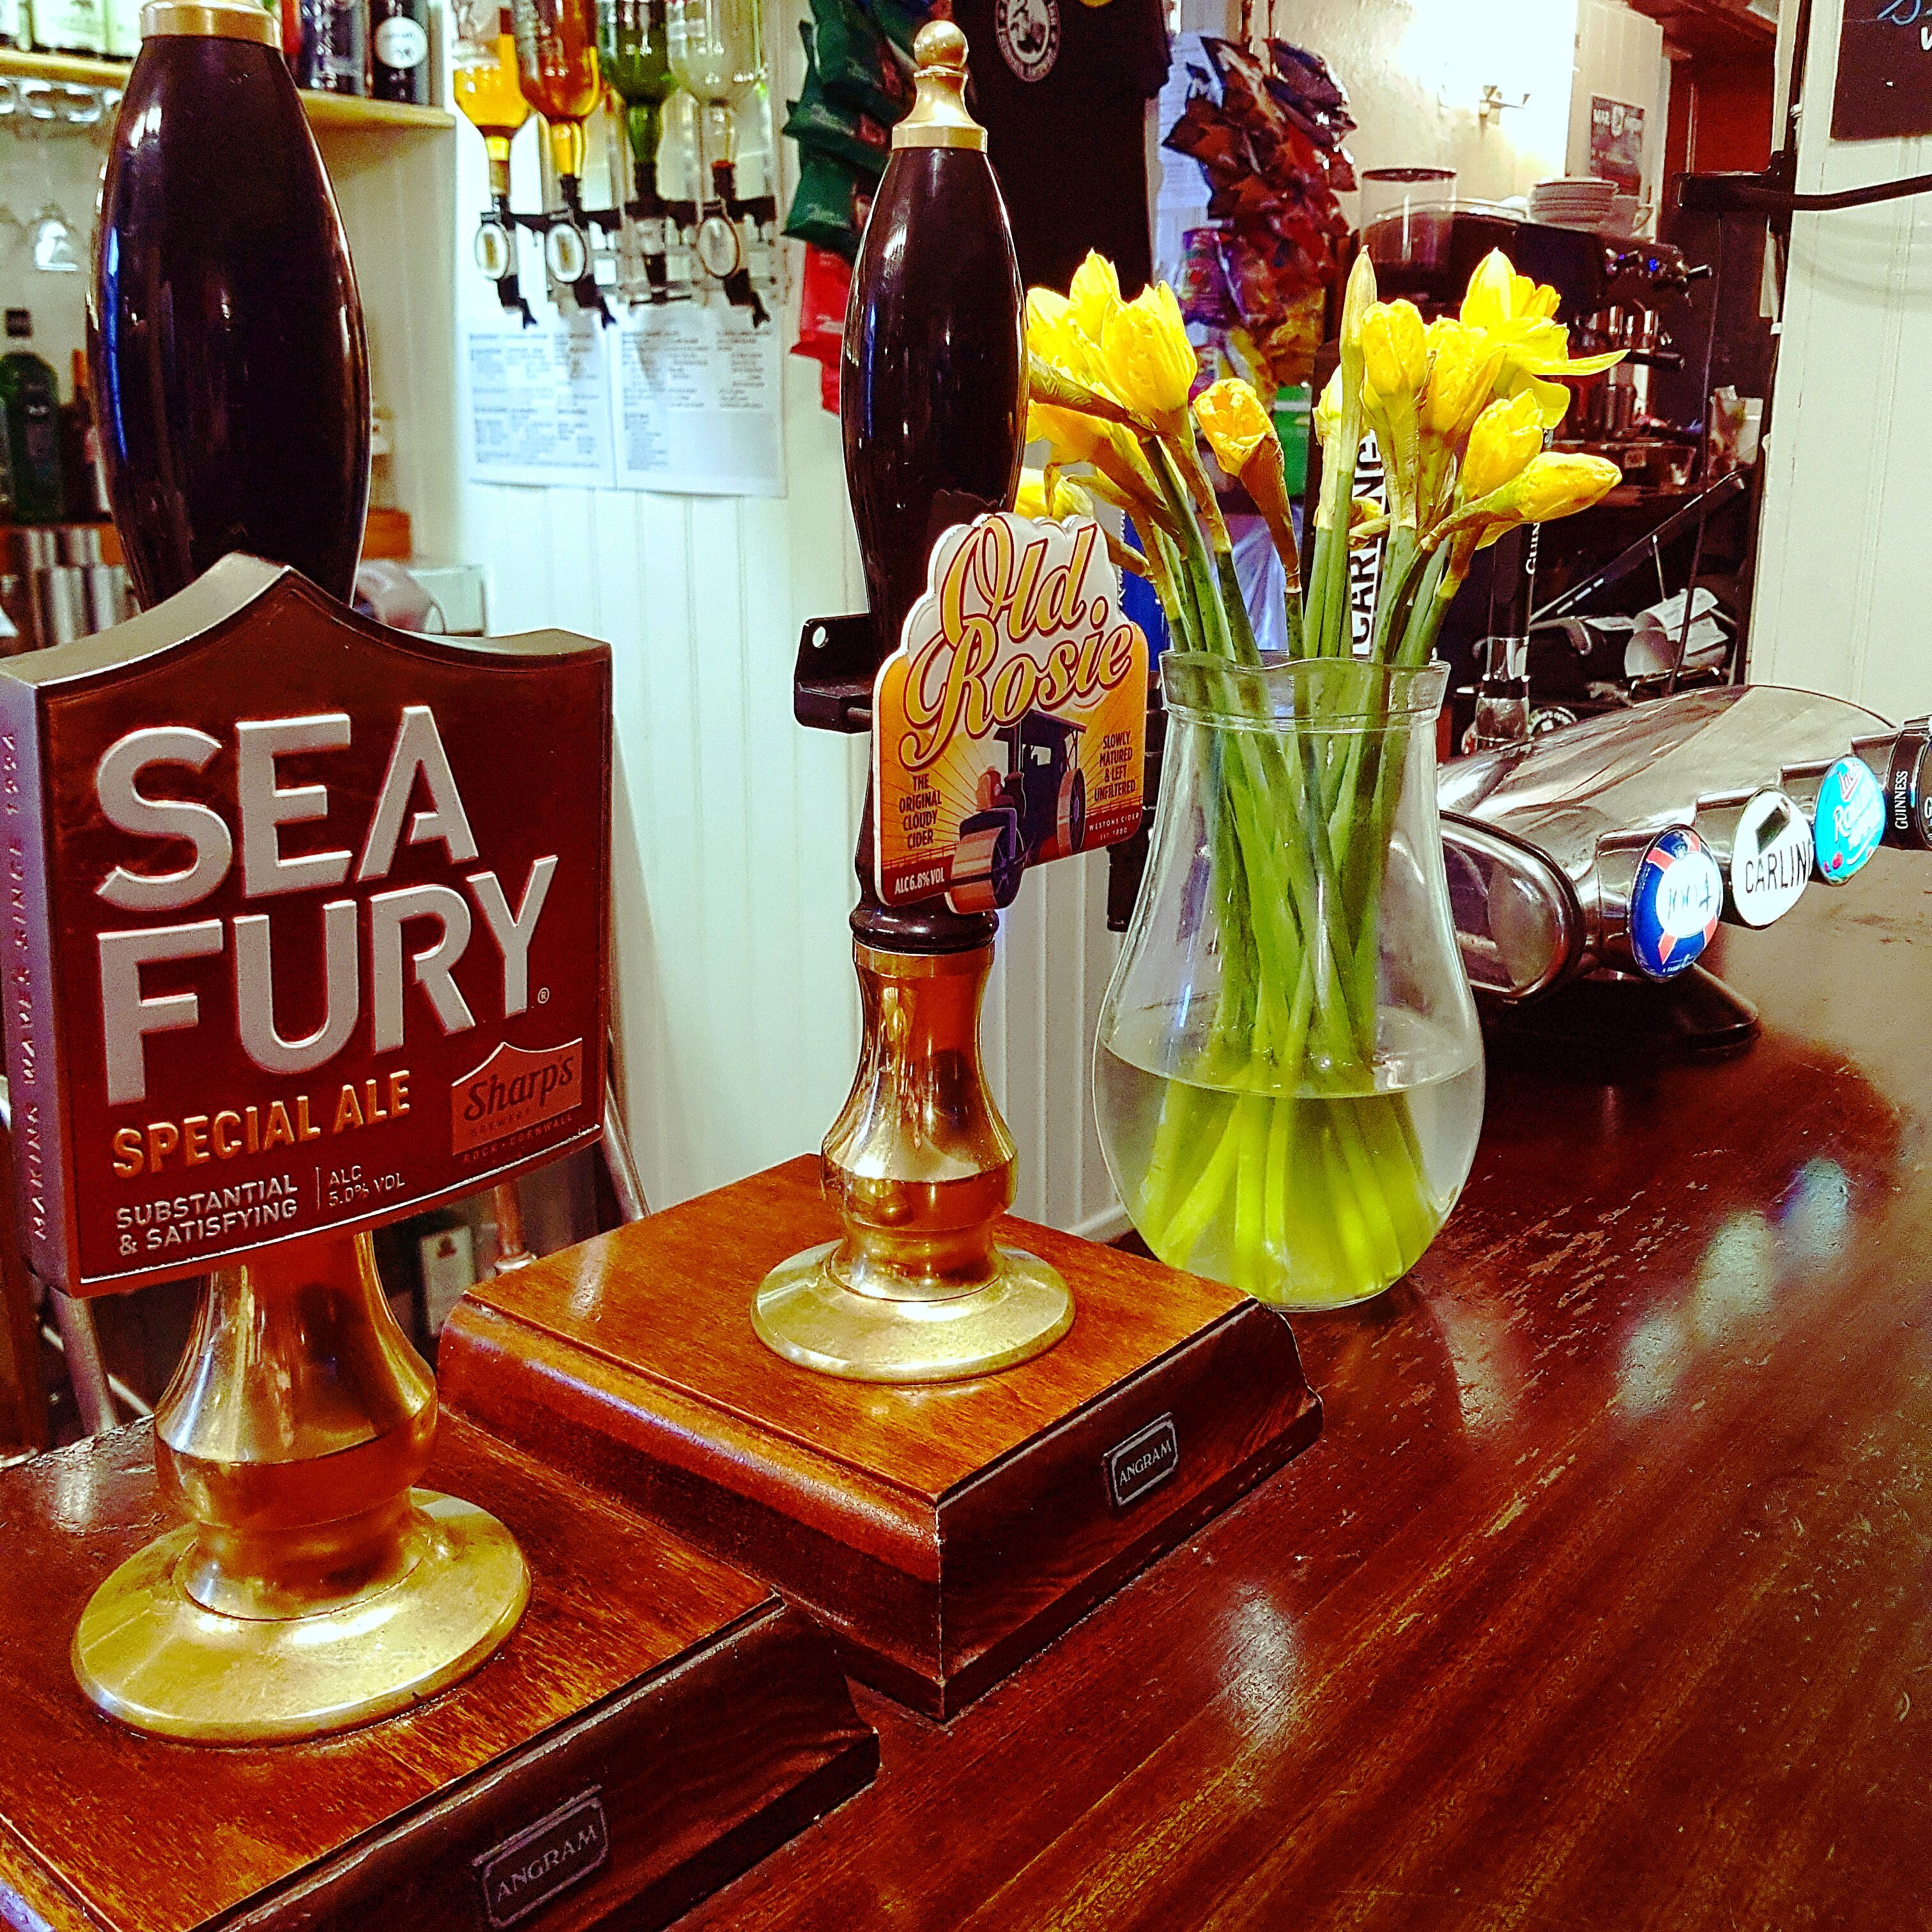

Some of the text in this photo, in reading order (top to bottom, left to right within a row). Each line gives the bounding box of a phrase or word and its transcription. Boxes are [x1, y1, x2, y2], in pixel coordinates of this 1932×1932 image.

[1349, 442, 1385, 645] CARNG
[1526, 521, 1540, 574] GUIN
[940, 515, 1098, 651] Old
[898, 595, 1133, 772] Rosie
[1099, 747, 1133, 767] MATURED
[1103, 731, 1131, 749] SLOWLY
[912, 773, 930, 792] THE
[1094, 779, 1136, 801] UNFILTERED
[1104, 765, 1128, 783] & LEFT
[1894, 770, 1908, 829] GUINNESS
[95, 705, 479, 912] SEA
[899, 790, 942, 814] ORIGINAL
[903, 809, 938, 832] CLOUDY
[1089, 812, 1140, 831] WESTONS CIDER
[907, 829, 934, 849] CIDER
[895, 877, 909, 894] ALC
[930, 867, 945, 885] VOL
[97, 855, 558, 1107] FURY
[464, 1054, 574, 1122] Sharp's
[112, 1070, 410, 1179] SPECIAL ALE
[116, 1165, 362, 1230] SUBSTANTIAL ALC
[119, 1172, 406, 1256] & SATISFYING 5.0% VOL
[1119, 1439, 1172, 1487] ANGRAM
[497, 1825, 598, 1902] ANGRAM
